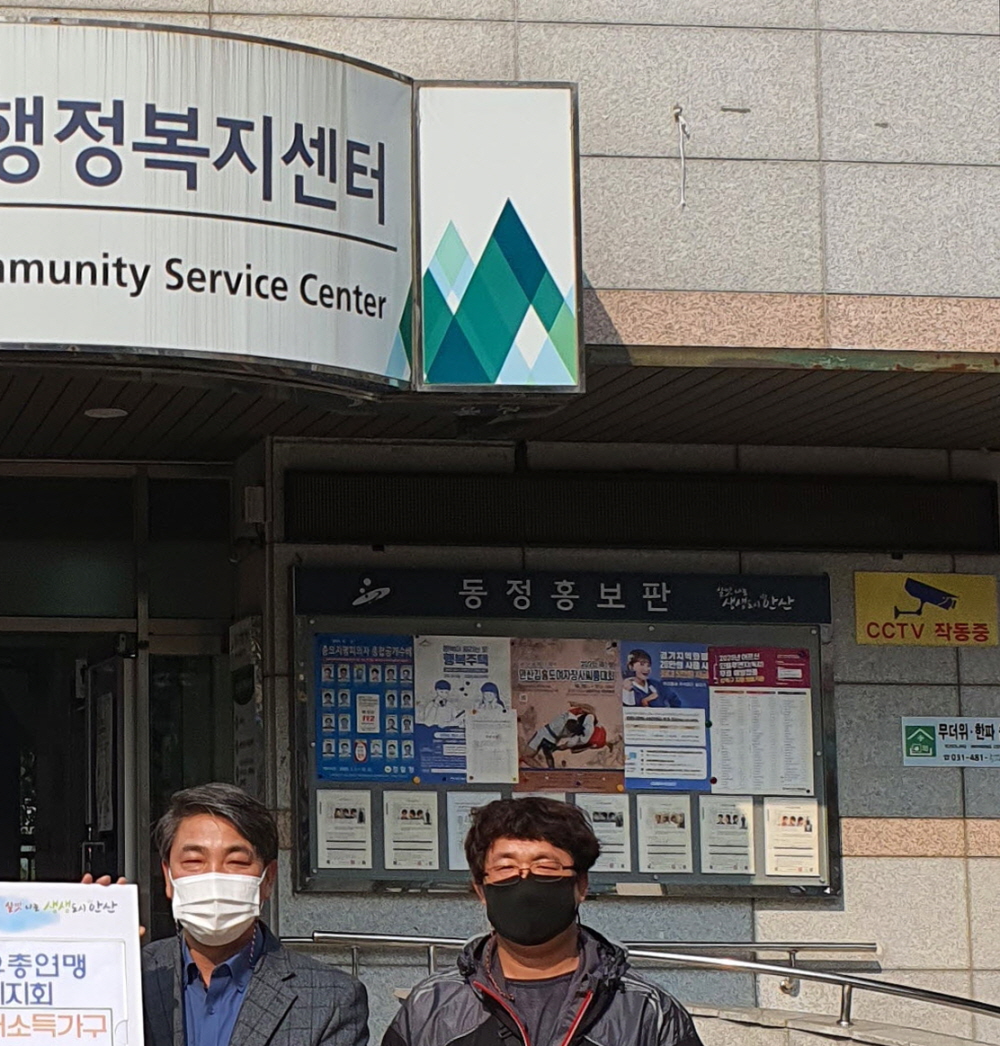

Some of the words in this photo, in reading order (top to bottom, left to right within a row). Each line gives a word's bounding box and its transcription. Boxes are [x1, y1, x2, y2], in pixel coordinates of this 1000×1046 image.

[165, 257, 289, 302] Service
[299, 273, 387, 320] Center
[867, 620, 928, 639] CCTV
[934, 620, 990, 642] 작동중
